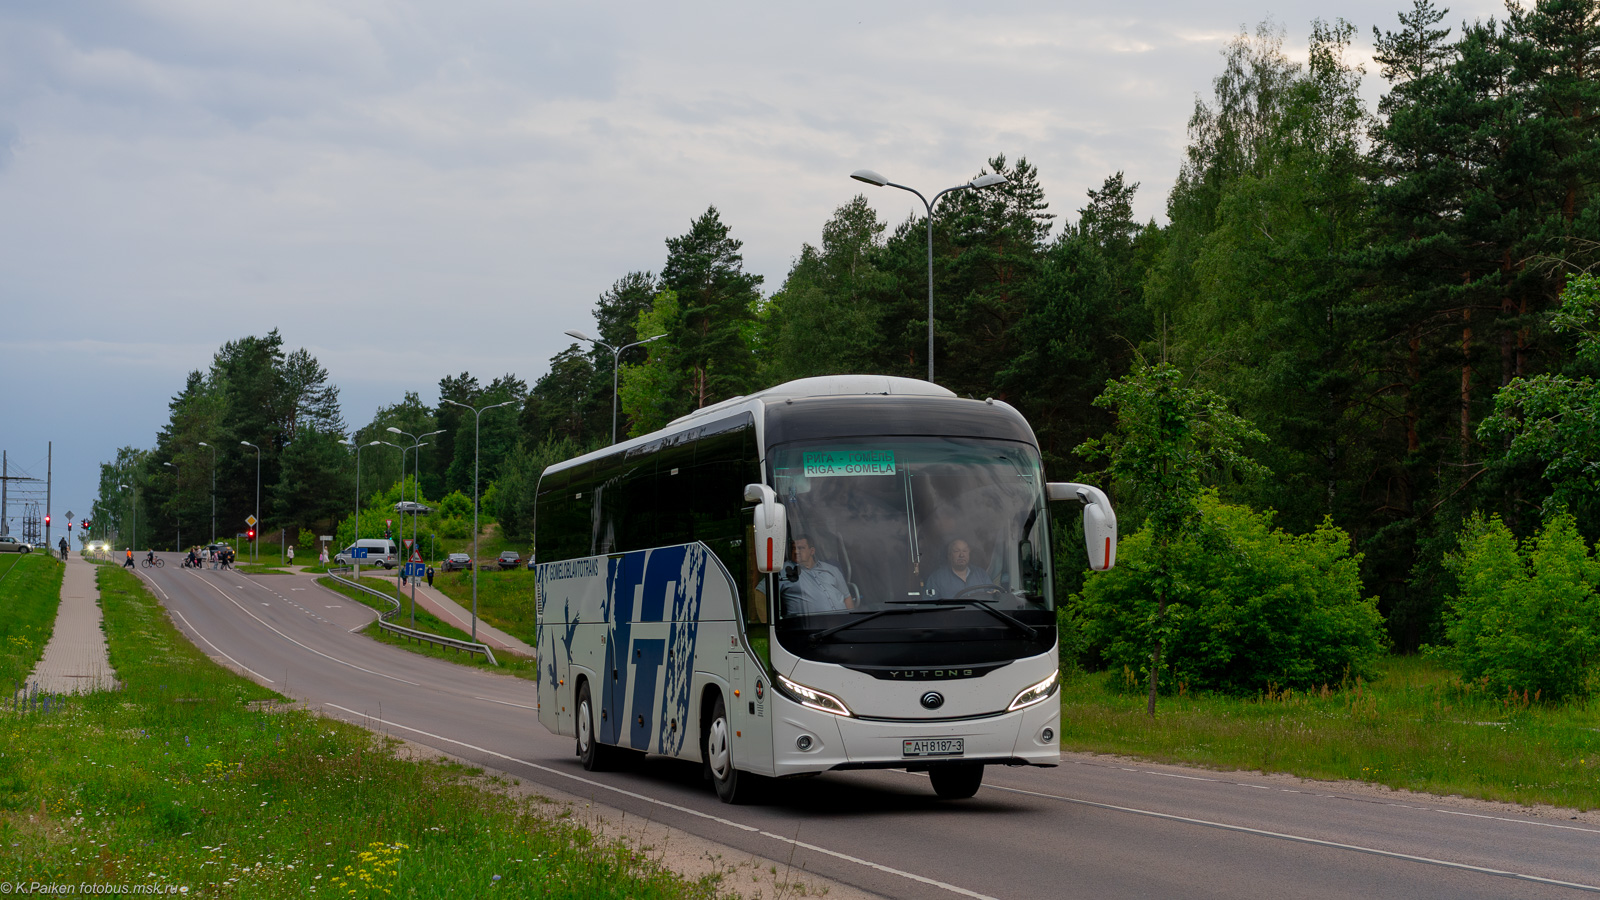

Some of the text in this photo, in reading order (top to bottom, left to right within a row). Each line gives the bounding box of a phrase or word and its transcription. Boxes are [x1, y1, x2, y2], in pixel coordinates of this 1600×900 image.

[806, 453, 834, 463] РИГА
[848, 452, 893, 462] ГОМЕЛЬ
[807, 464, 835, 474] RIGA
[890, 669, 973, 678] YUTONG
[913, 740, 962, 752] AH8187-3
